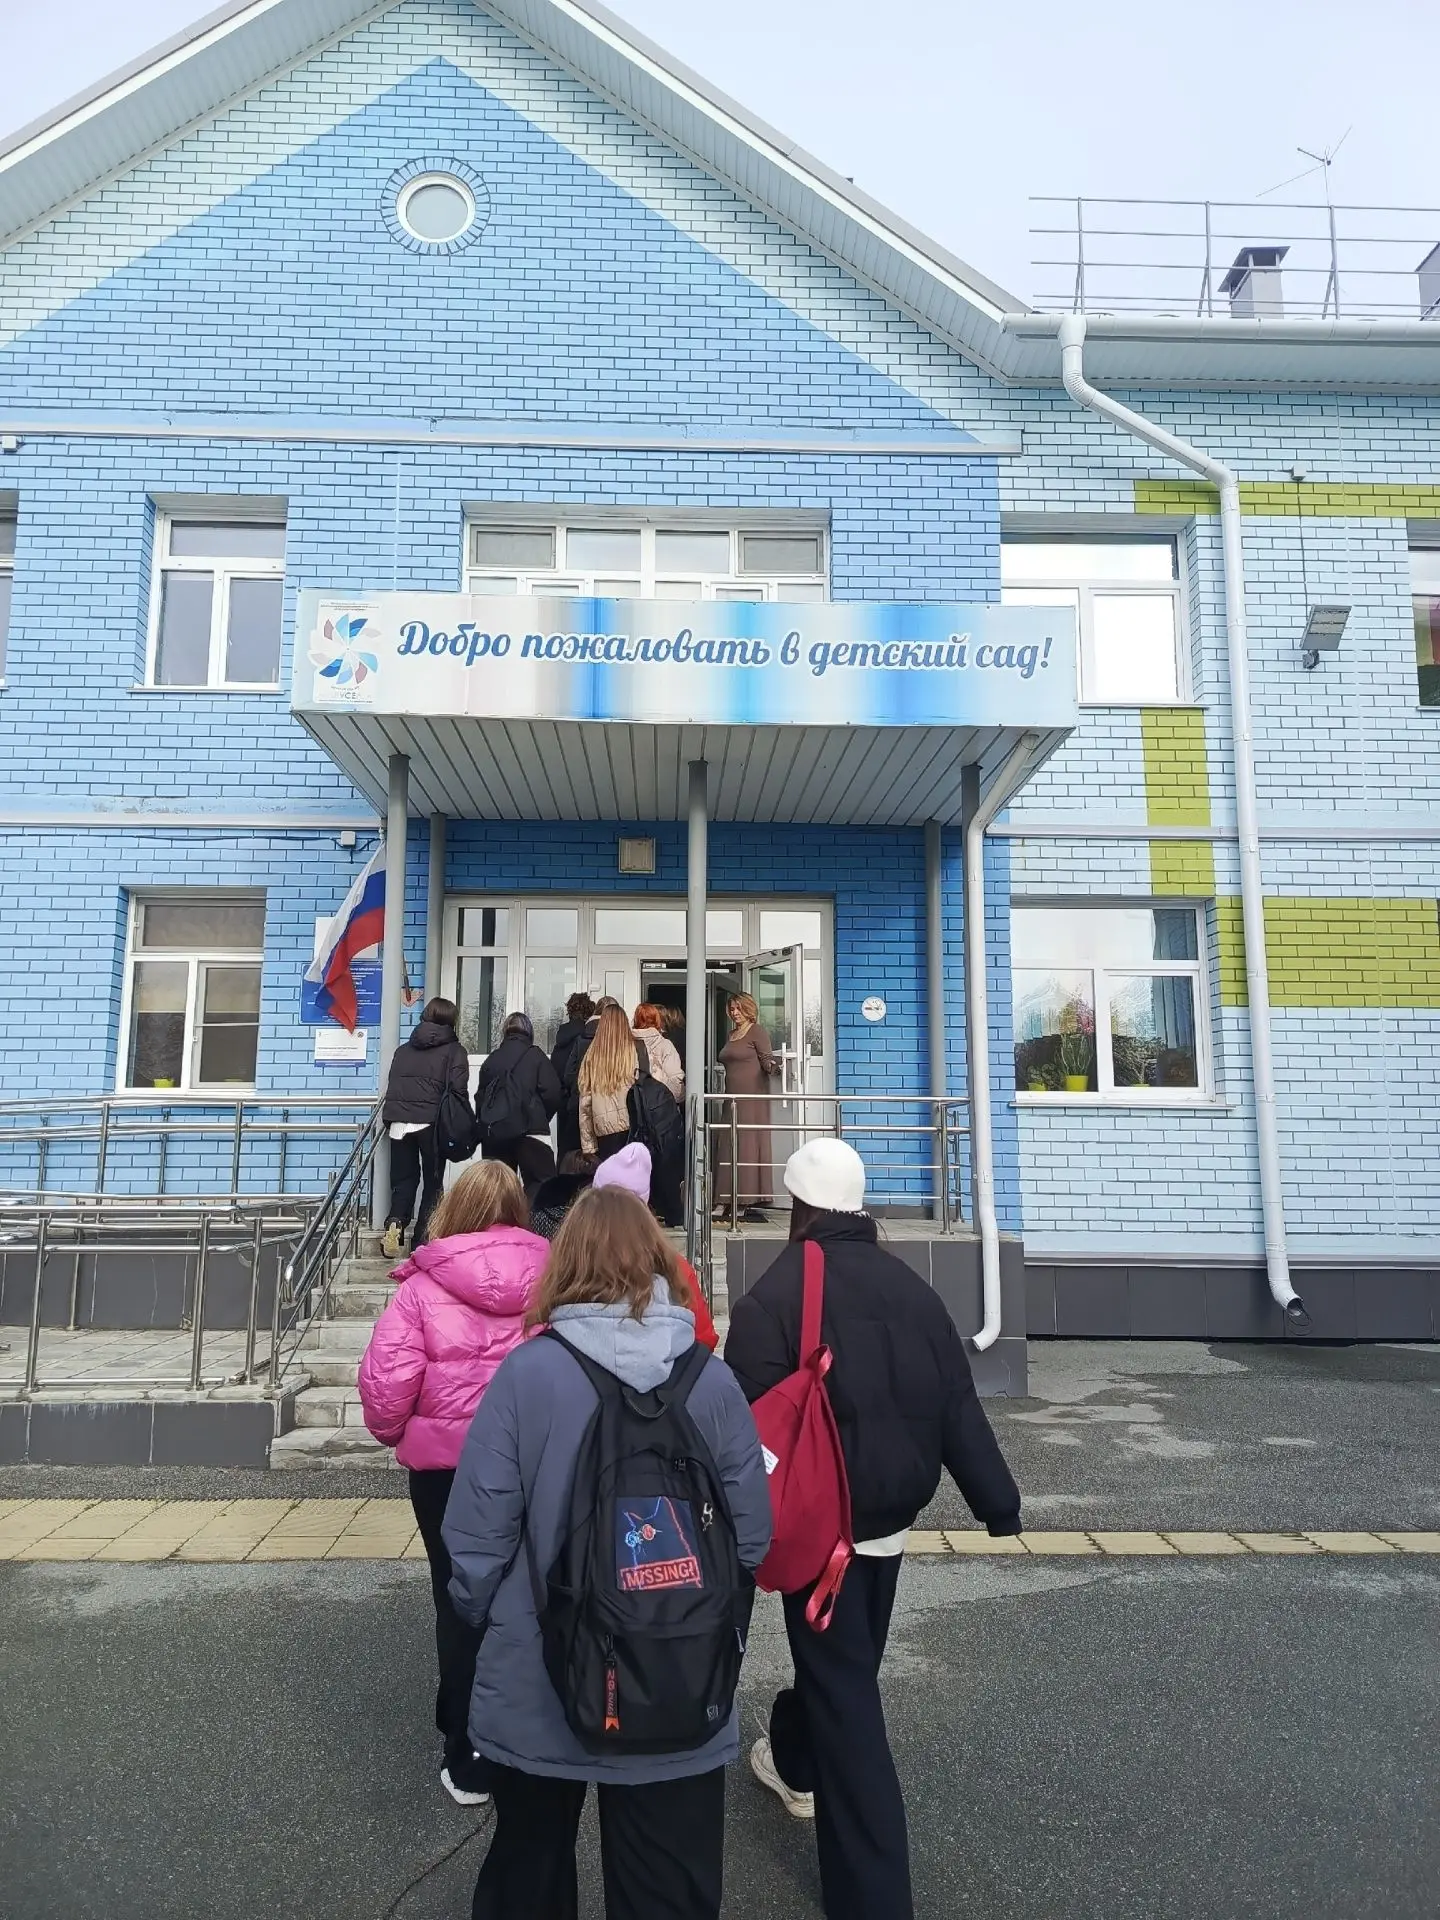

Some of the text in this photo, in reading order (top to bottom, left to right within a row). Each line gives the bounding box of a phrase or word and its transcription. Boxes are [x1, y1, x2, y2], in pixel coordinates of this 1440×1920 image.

[397, 621, 1053, 679] Добро пожаловать в детский сад!
[626, 1561, 695, 1588] MISSING!
